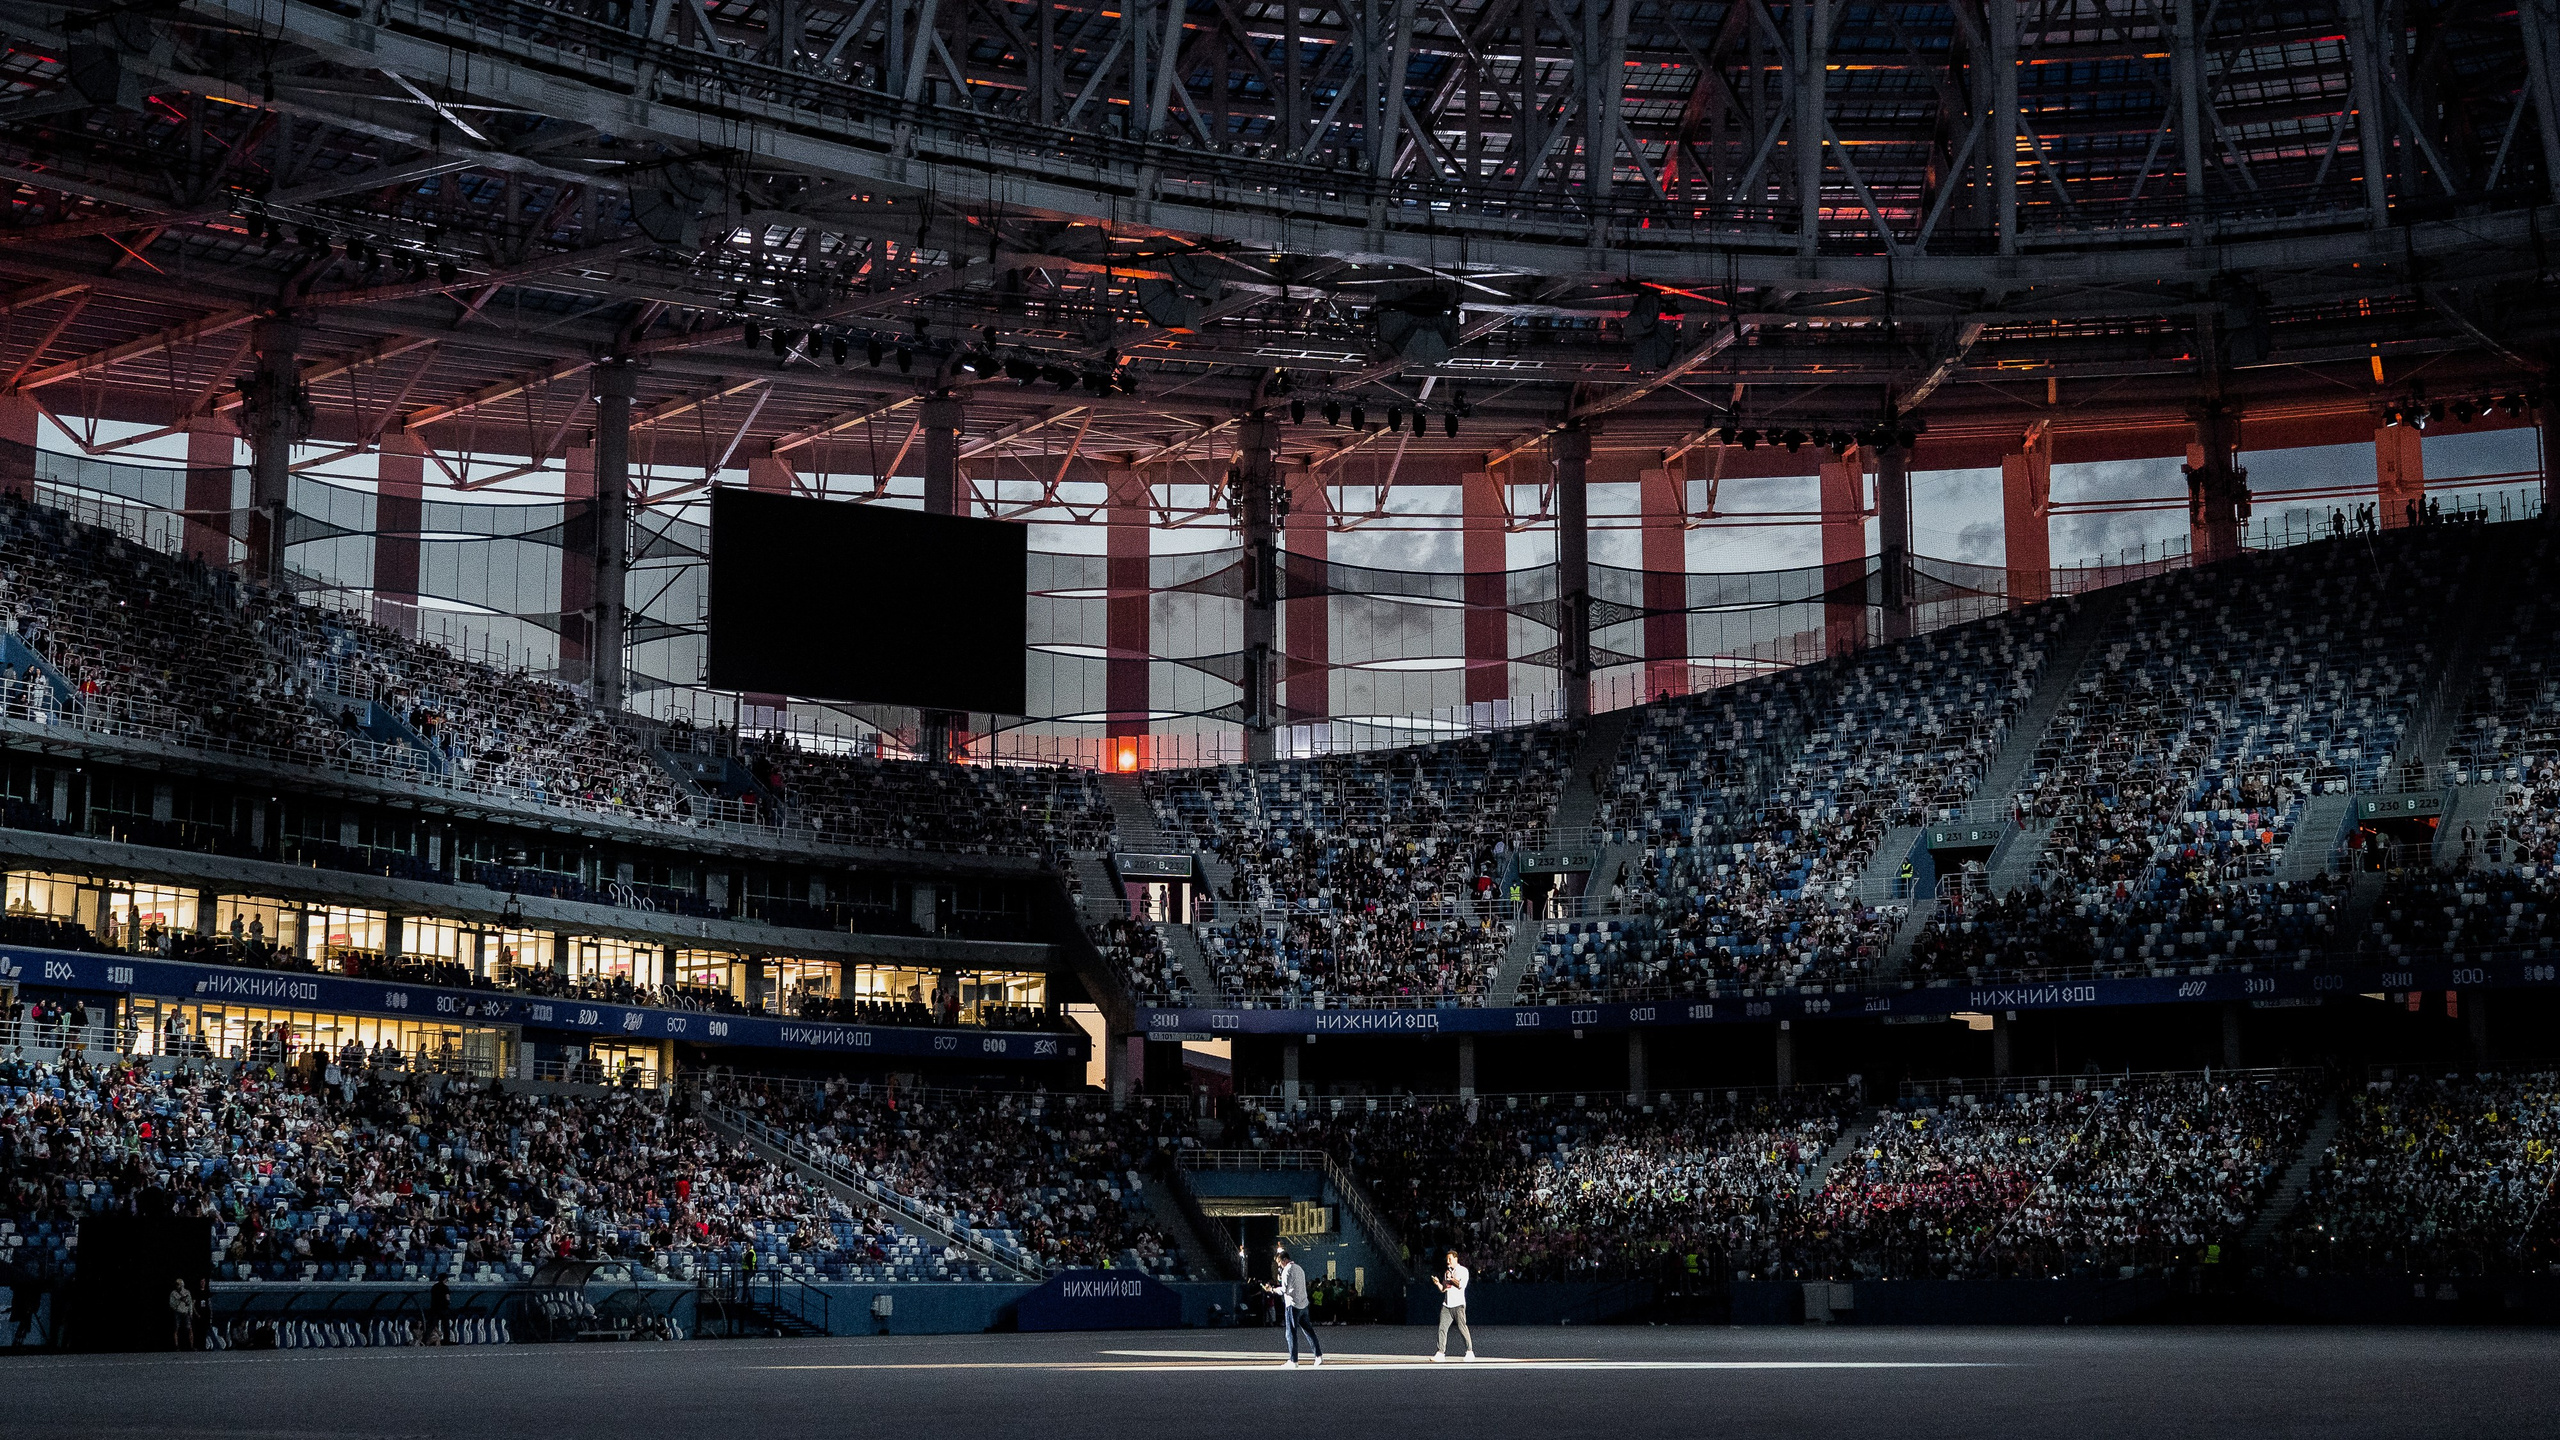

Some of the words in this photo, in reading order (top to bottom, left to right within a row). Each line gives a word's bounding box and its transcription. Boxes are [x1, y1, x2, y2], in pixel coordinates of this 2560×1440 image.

[2367, 802, 2377, 812] B
[2380, 801, 2400, 811] 230
[2407, 799, 2416, 810] B
[2419, 798, 2439, 808] 229
[1935, 833, 1944, 842] B
[1946, 832, 1962, 841] 231
[1971, 831, 1979, 840] B
[1982, 830, 2000, 839] 230
[1123, 859, 1132, 868] A
[1158, 861, 1166, 870] B
[1528, 858, 1535, 867] B
[1538, 857, 1555, 866] 232
[1562, 856, 1569, 866] B
[1572, 856, 1588, 865] 231
[208, 974, 287, 998] НИЖНИЙ
[1970, 985, 2059, 1007] НИЖНИЙ
[1316, 1011, 1402, 1029] НИЖНИЙ
[780, 1026, 845, 1046] НИЖНИЙ
[1063, 1276, 1120, 1298] НИЖНИЙ
[1121, 1279, 1142, 1297] 800
